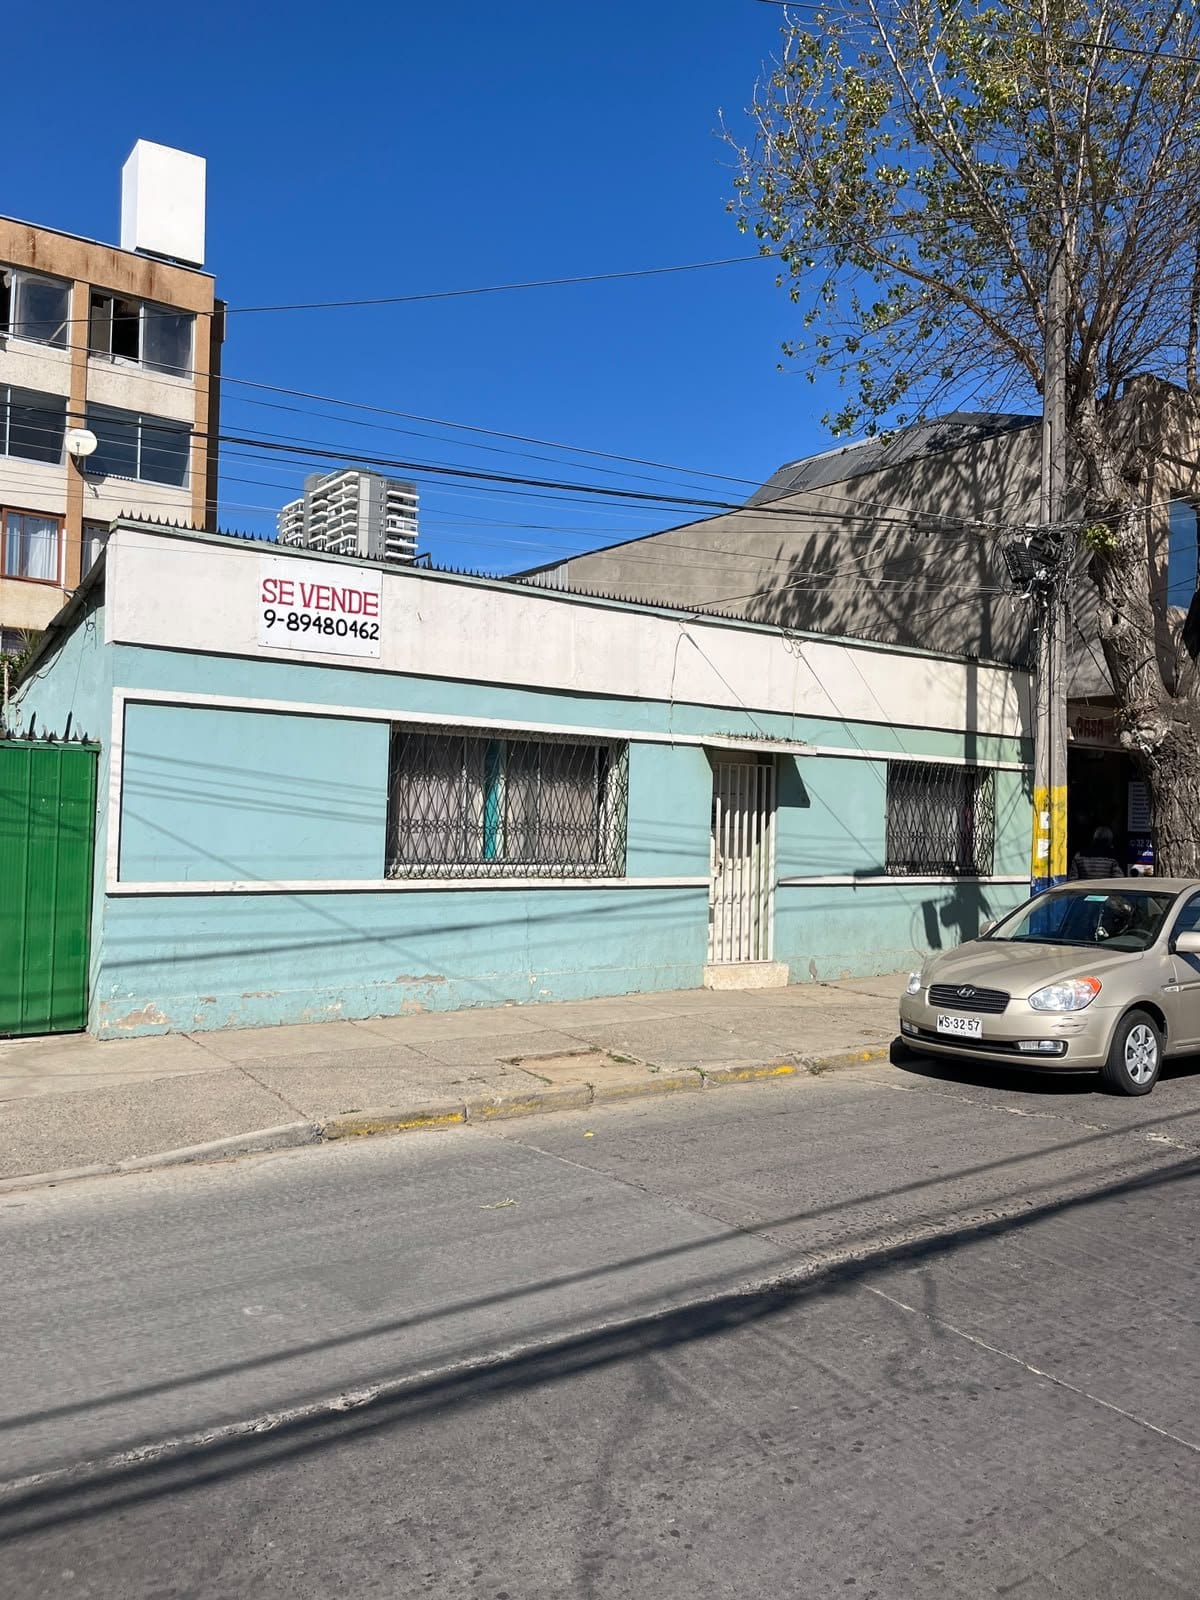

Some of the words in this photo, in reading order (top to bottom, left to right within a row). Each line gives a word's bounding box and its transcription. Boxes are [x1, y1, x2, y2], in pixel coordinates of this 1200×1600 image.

[262, 578, 295, 606] SE
[299, 582, 379, 617] VENDE
[264, 609, 380, 640] 9-89480462
